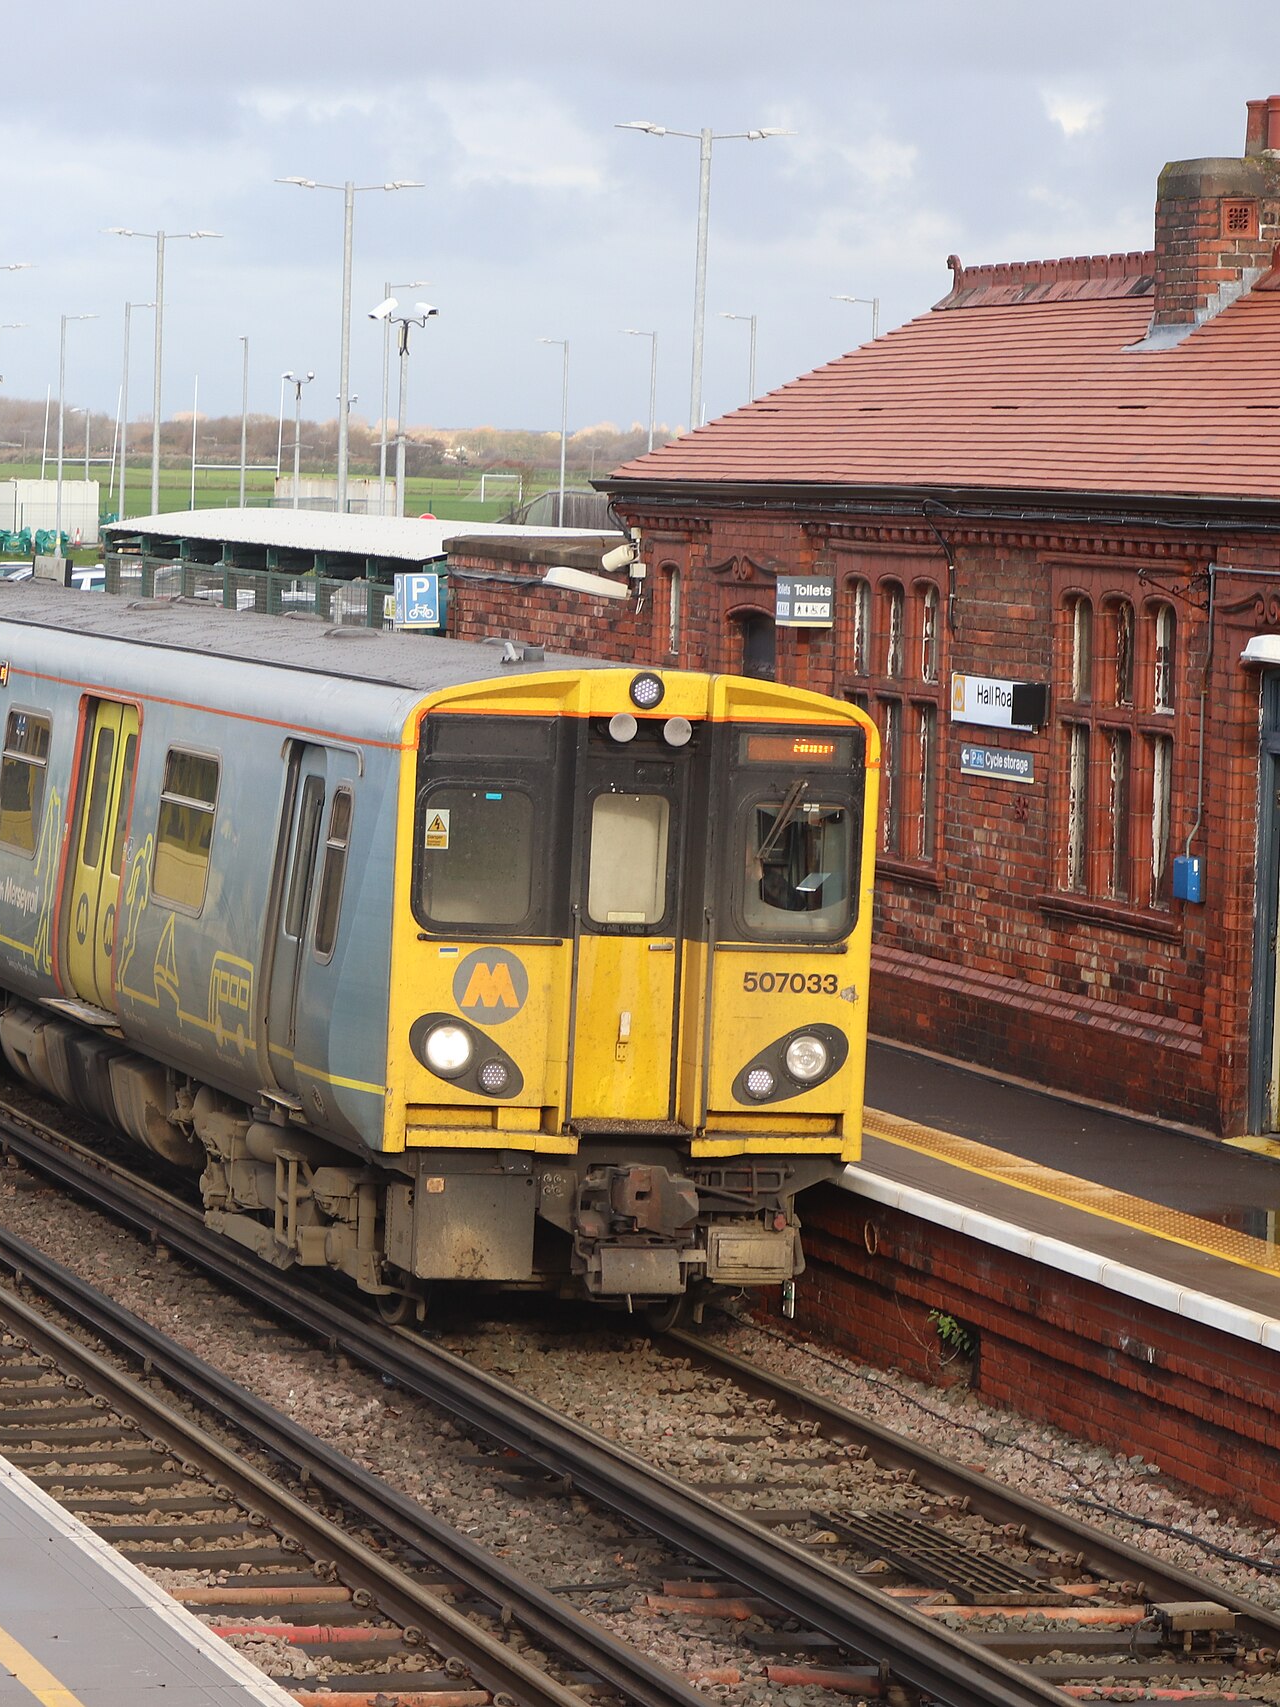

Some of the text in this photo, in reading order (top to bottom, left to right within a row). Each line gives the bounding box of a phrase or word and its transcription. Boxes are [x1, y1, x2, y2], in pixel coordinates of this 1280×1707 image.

[412, 577, 430, 602] P
[794, 583, 832, 597] Toilets
[977, 684, 1013, 708] Hall Roa
[985, 751, 1029, 774] Cycle storage
[4, 876, 39, 917] Merseyrail
[743, 971, 838, 995] 507033
